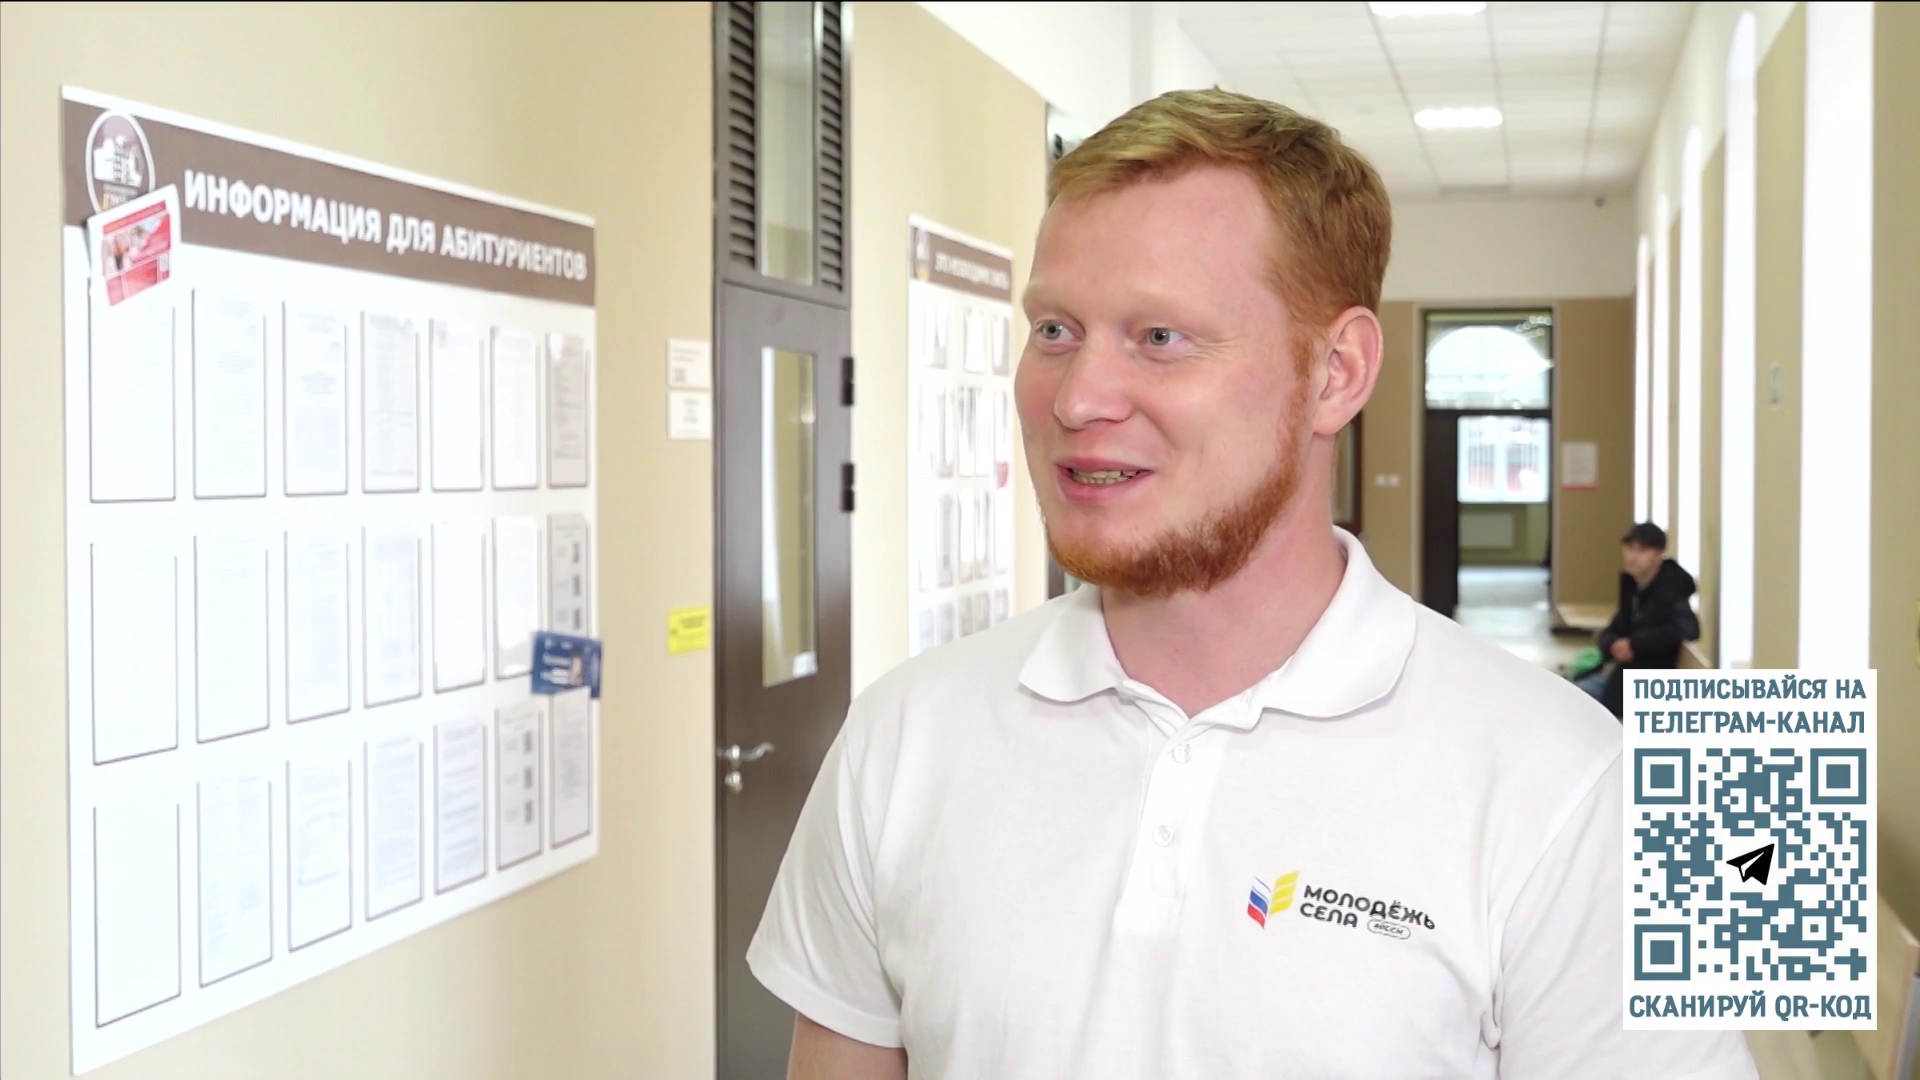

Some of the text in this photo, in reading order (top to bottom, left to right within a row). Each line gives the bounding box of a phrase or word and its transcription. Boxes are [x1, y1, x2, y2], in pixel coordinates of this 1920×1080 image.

[184, 169, 381, 243] ИНФОРМАЦИЯ
[386, 213, 436, 254] ДЛЯ
[440, 225, 588, 280] АБИТУРИЕНТОВ
[1300, 902, 1358, 928] СЕЛА
[1303, 884, 1436, 930] МОЛОДЁЖЬ
